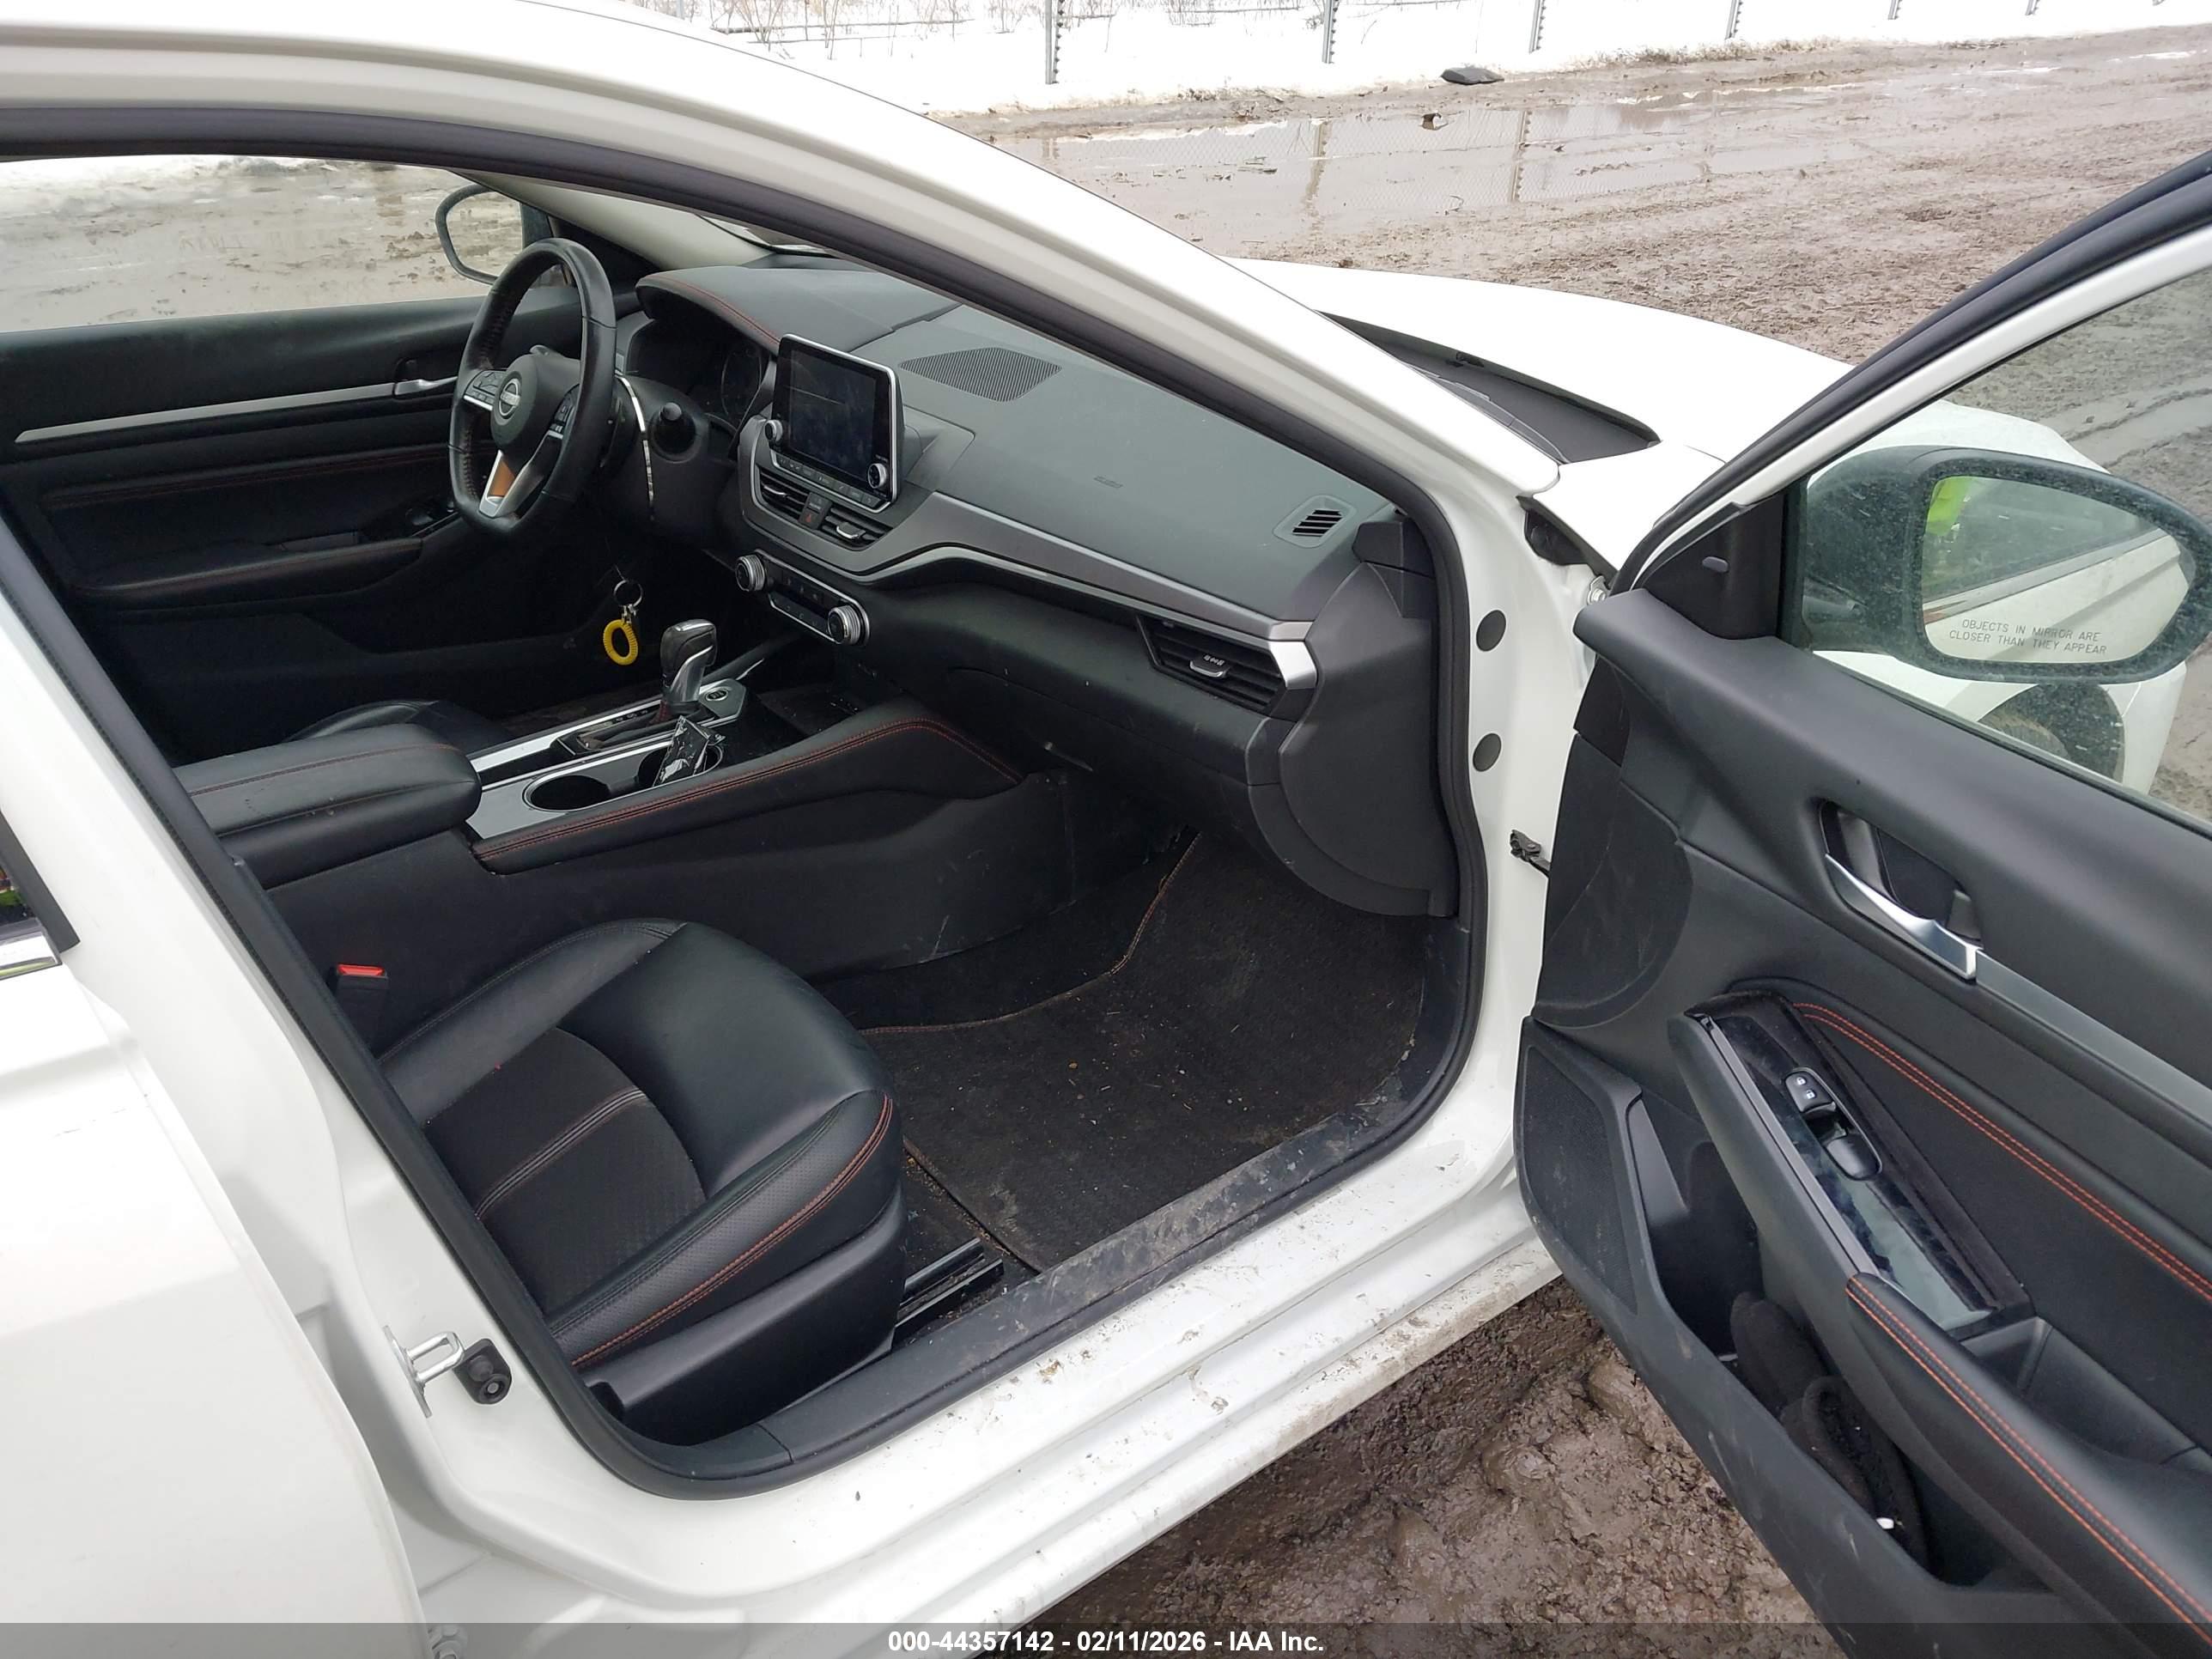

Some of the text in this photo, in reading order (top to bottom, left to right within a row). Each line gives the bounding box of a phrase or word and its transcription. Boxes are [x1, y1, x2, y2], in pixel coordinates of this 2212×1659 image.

[1949, 629, 2107, 654] CLOSER THAN THEY APPEAR
[1962, 619, 2103, 642] OBJECTS IN MIRROR ARE
